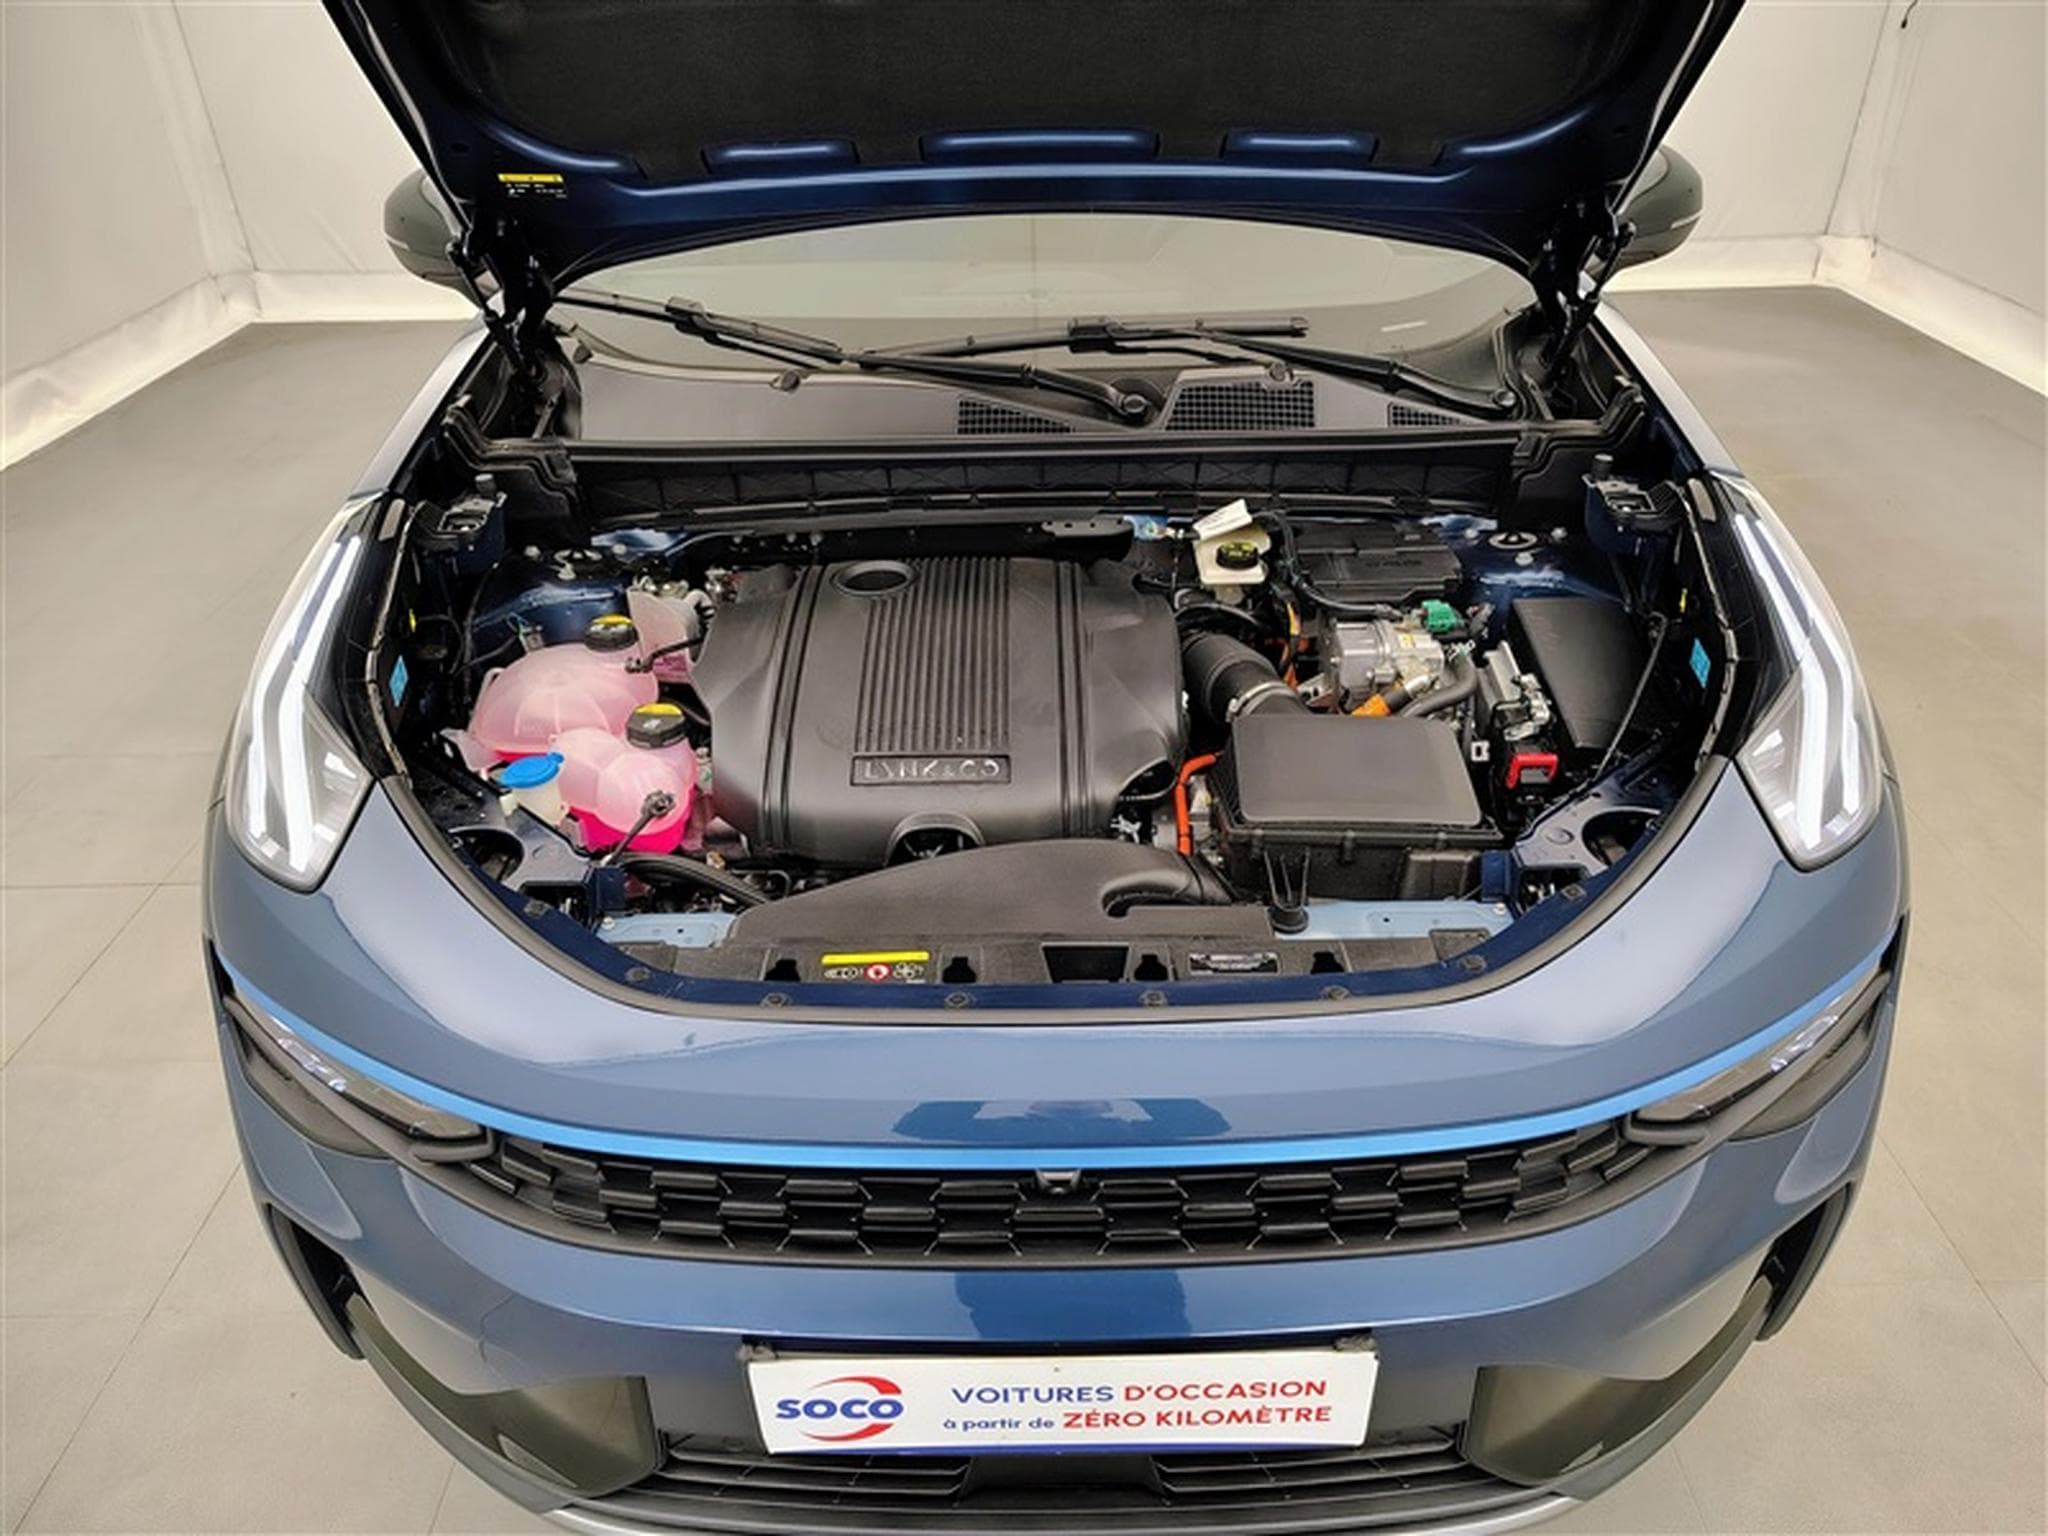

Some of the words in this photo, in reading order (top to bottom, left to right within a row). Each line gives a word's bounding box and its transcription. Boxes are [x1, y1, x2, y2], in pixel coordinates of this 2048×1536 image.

[952, 1386, 1114, 1404] VOITURES
[1125, 1381, 1326, 1401] D'OCCASION
[776, 1399, 904, 1419] SOCO
[963, 1417, 1021, 1432] partir
[1028, 1417, 1055, 1430] de
[1063, 1409, 1146, 1428] ZÉRO
[1156, 1405, 1332, 1426] KILOMÈTRE
